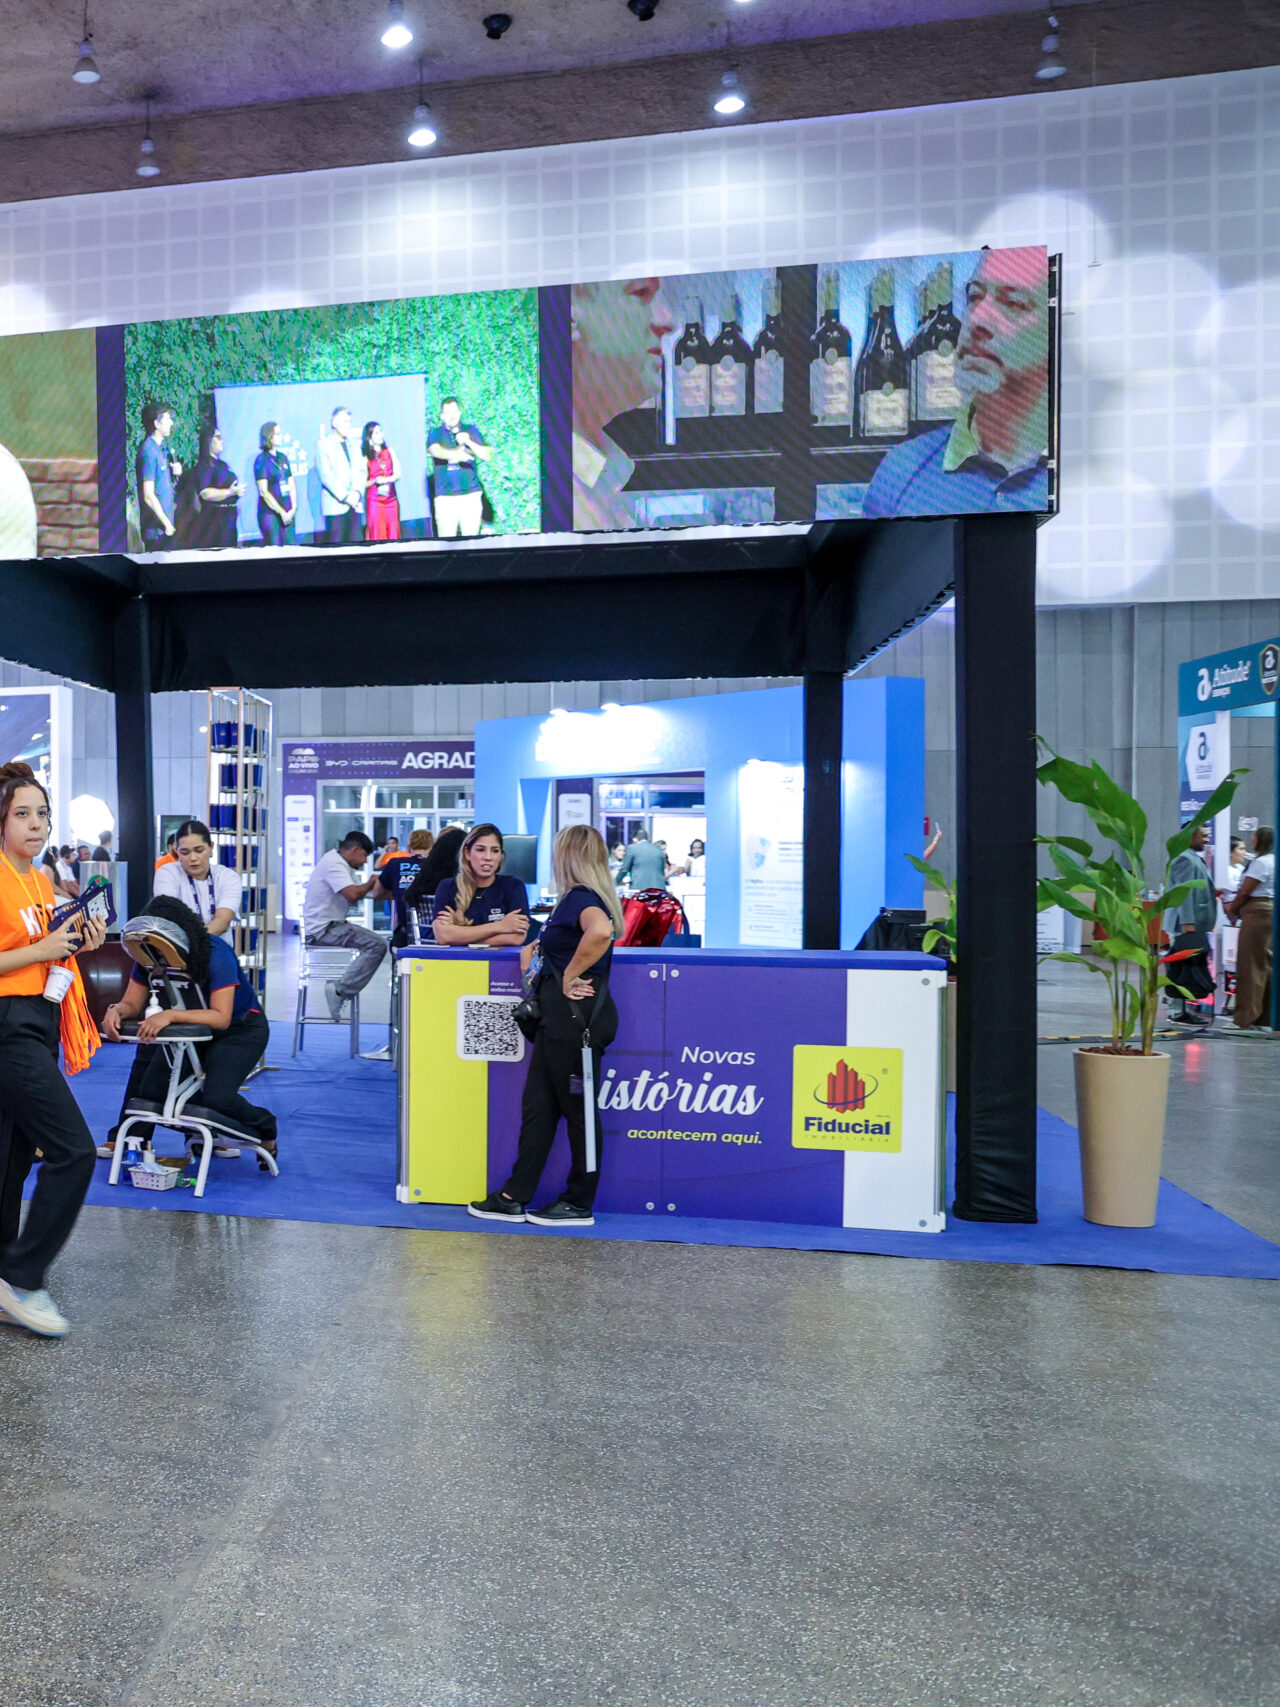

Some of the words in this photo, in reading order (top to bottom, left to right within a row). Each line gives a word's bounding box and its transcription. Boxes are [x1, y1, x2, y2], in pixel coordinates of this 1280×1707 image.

[680, 1046, 756, 1066] Novas
[597, 1068, 764, 1115] istórias
[804, 1116, 891, 1135] Fiducial
[627, 1127, 717, 1143] acontecem
[721, 1130, 763, 1145] aqui.
